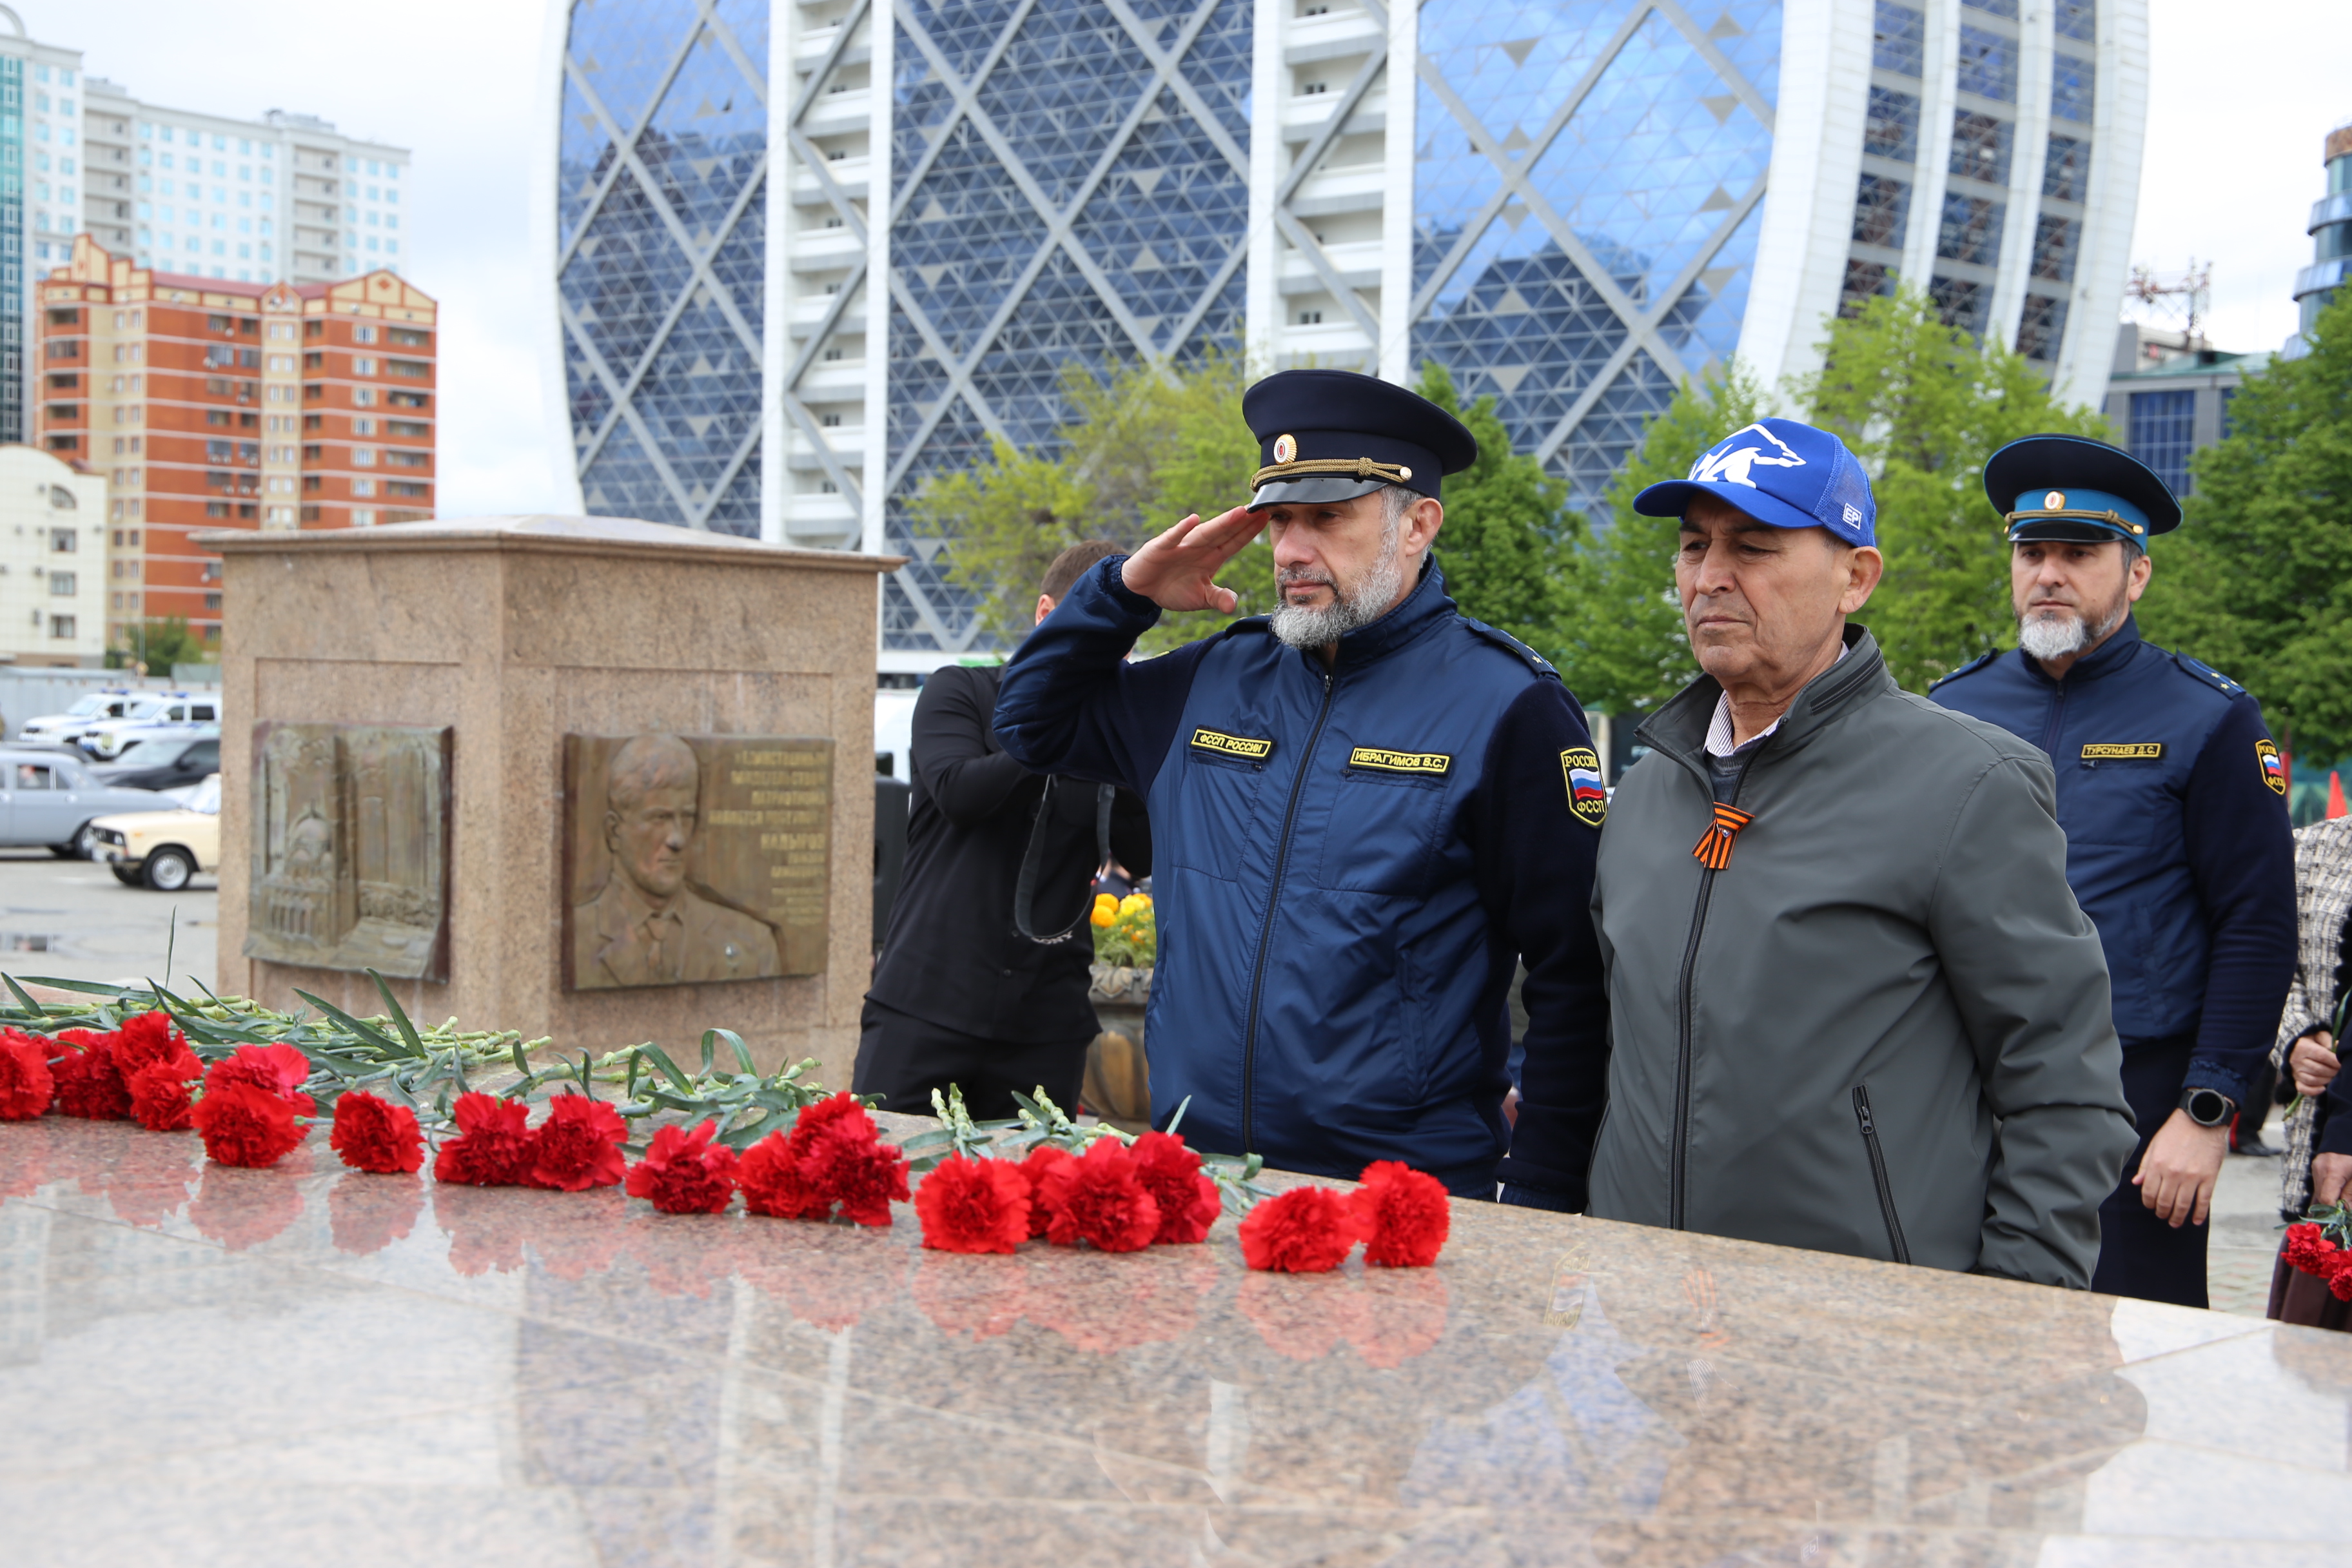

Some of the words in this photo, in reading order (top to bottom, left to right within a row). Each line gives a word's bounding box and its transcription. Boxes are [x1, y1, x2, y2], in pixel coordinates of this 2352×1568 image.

[1200, 734, 1225, 747] ФССП
[1226, 740, 1262, 753] РОССИИ
[1355, 751, 1420, 767] ИБРАГИМОВ
[1422, 758, 1443, 768] В.С.
[1577, 800, 1605, 813] ФССП
